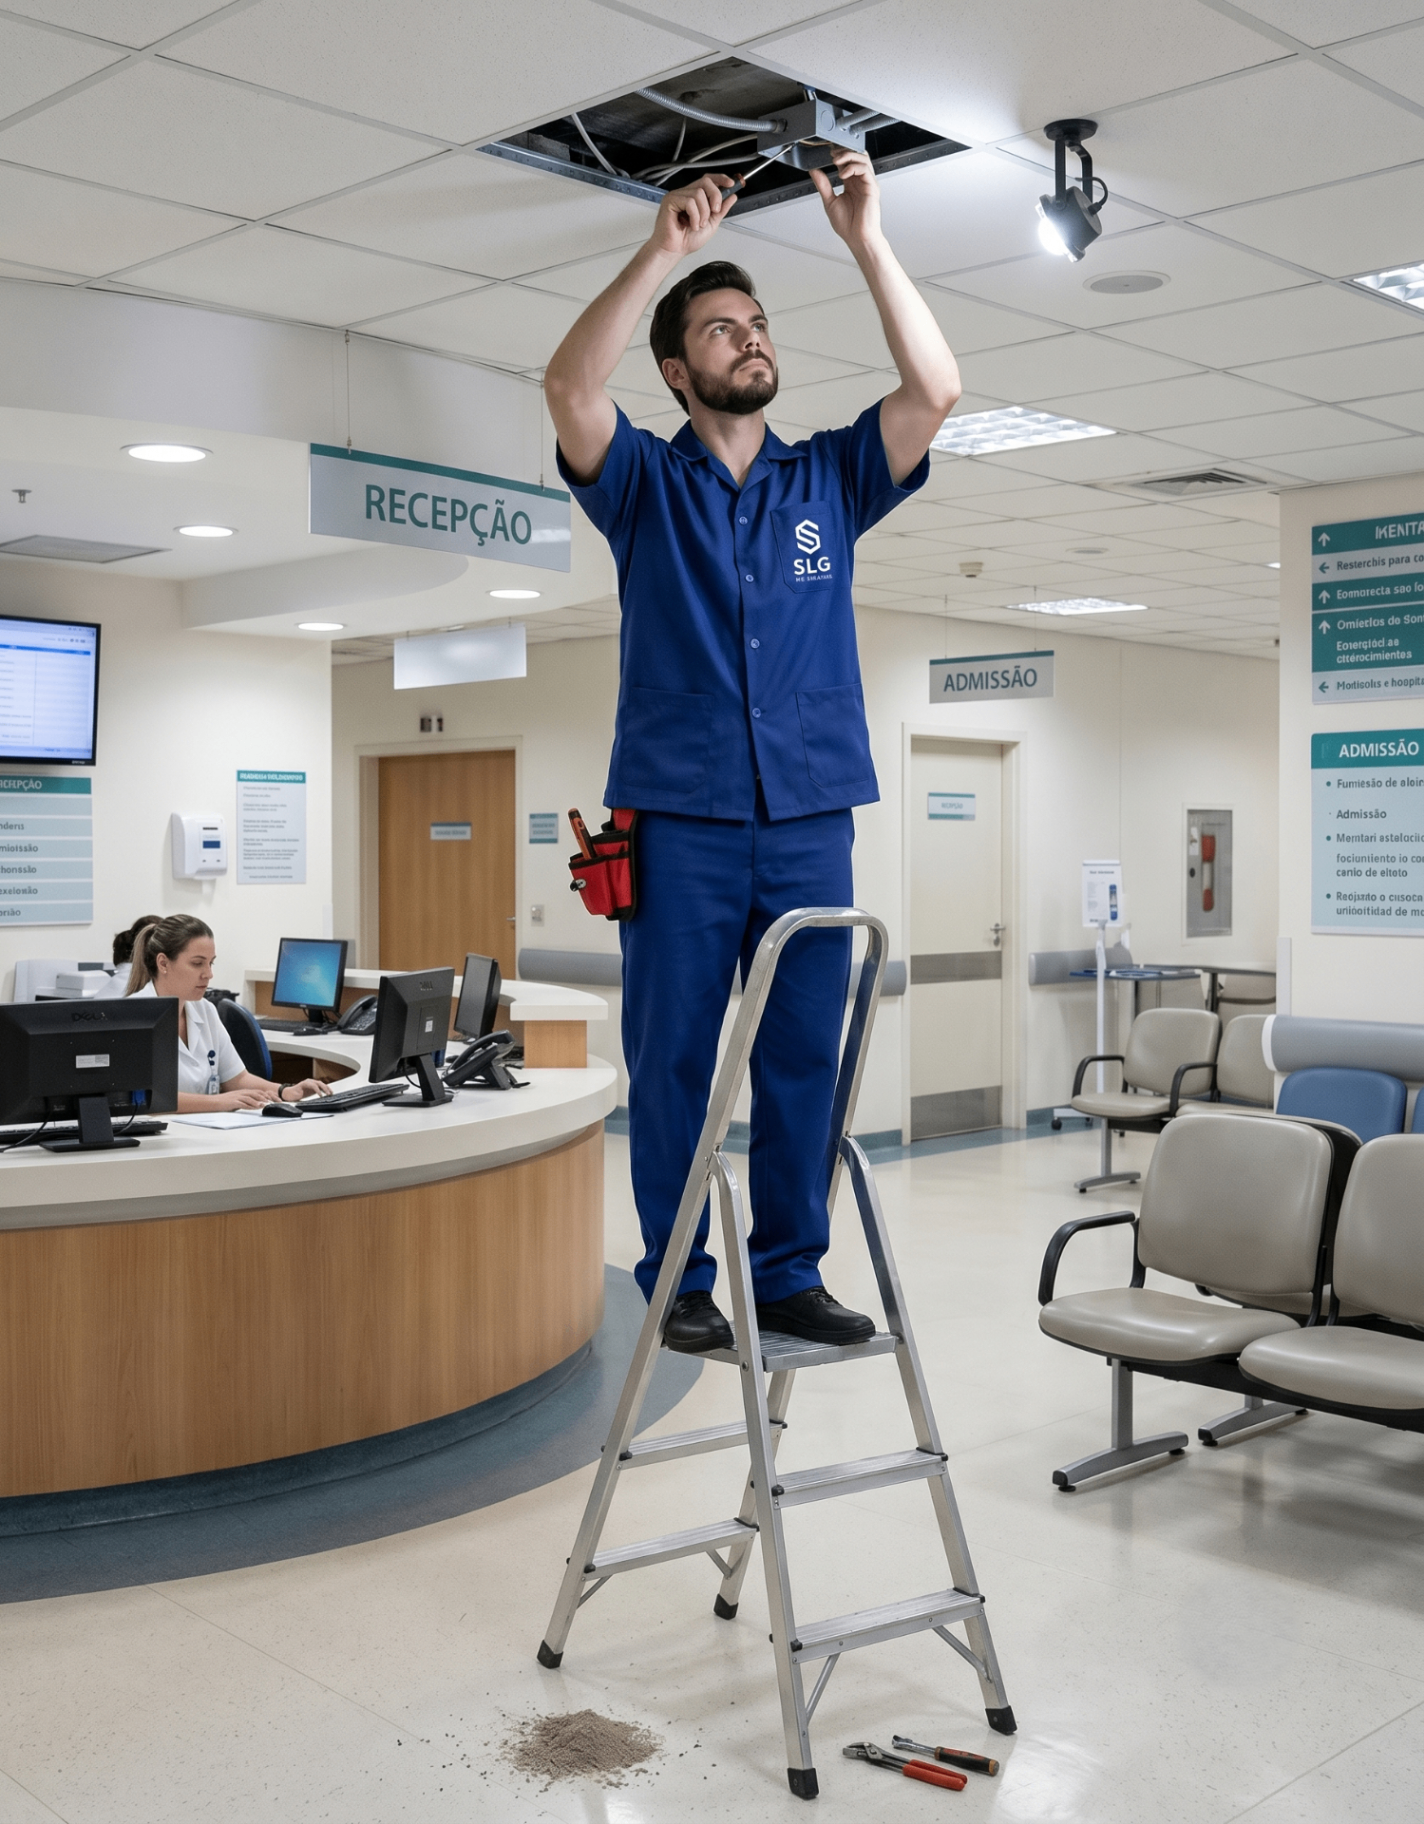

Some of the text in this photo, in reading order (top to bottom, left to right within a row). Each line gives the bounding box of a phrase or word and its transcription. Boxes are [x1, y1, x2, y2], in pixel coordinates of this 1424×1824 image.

[365, 484, 532, 547] RECEPÇÃO
[793, 556, 831, 576] SLG
[1389, 556, 1411, 568] para
[943, 665, 1038, 692] ADMISSÃO
[1338, 739, 1420, 758] ADMISSÃO
[1385, 777, 1398, 788] de
[1336, 809, 1387, 819] Admissão
[1365, 867, 1378, 877] de
[1380, 894, 1386, 902] o
[1395, 907, 1408, 917] de
